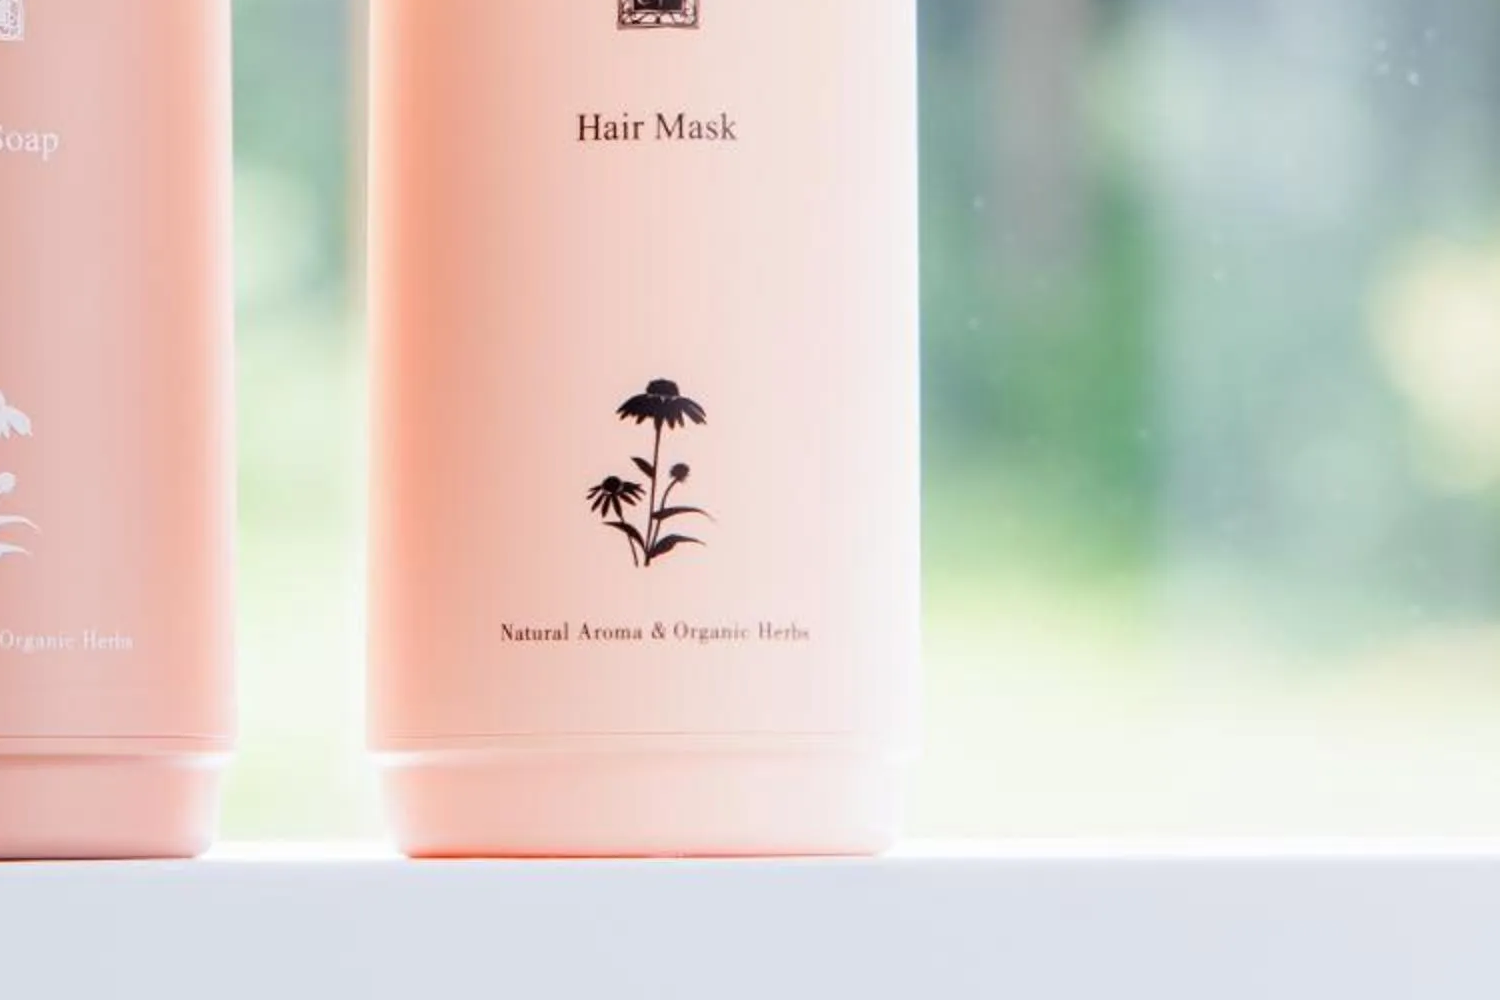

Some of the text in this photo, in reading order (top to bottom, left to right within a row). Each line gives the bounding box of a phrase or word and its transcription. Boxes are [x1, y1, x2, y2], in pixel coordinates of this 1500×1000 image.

[576, 111, 738, 142] Hair Mask
[500, 621, 811, 645] Natural Aroma & Organic Herbs
